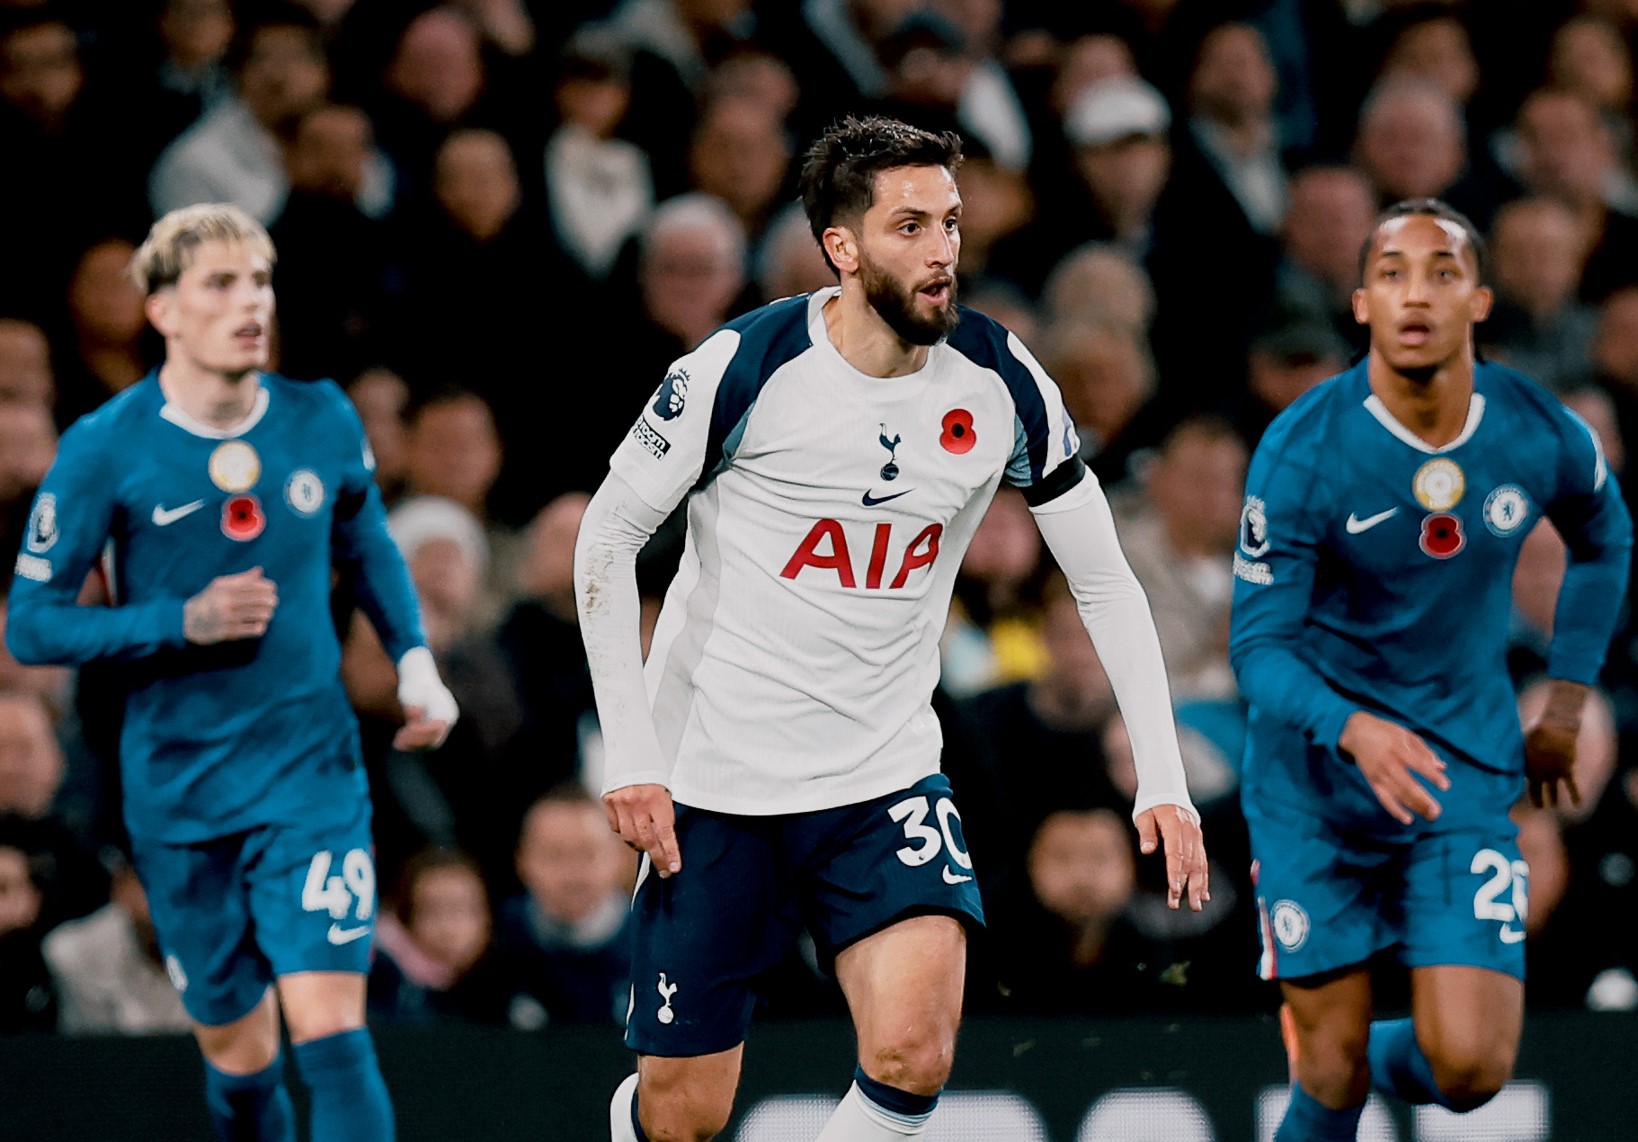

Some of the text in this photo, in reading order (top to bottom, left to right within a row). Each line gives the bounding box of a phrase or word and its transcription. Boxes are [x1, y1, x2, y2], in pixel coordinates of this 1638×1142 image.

[779, 518, 943, 589] AIA
[887, 795, 972, 870] 30
[302, 848, 375, 920] 49
